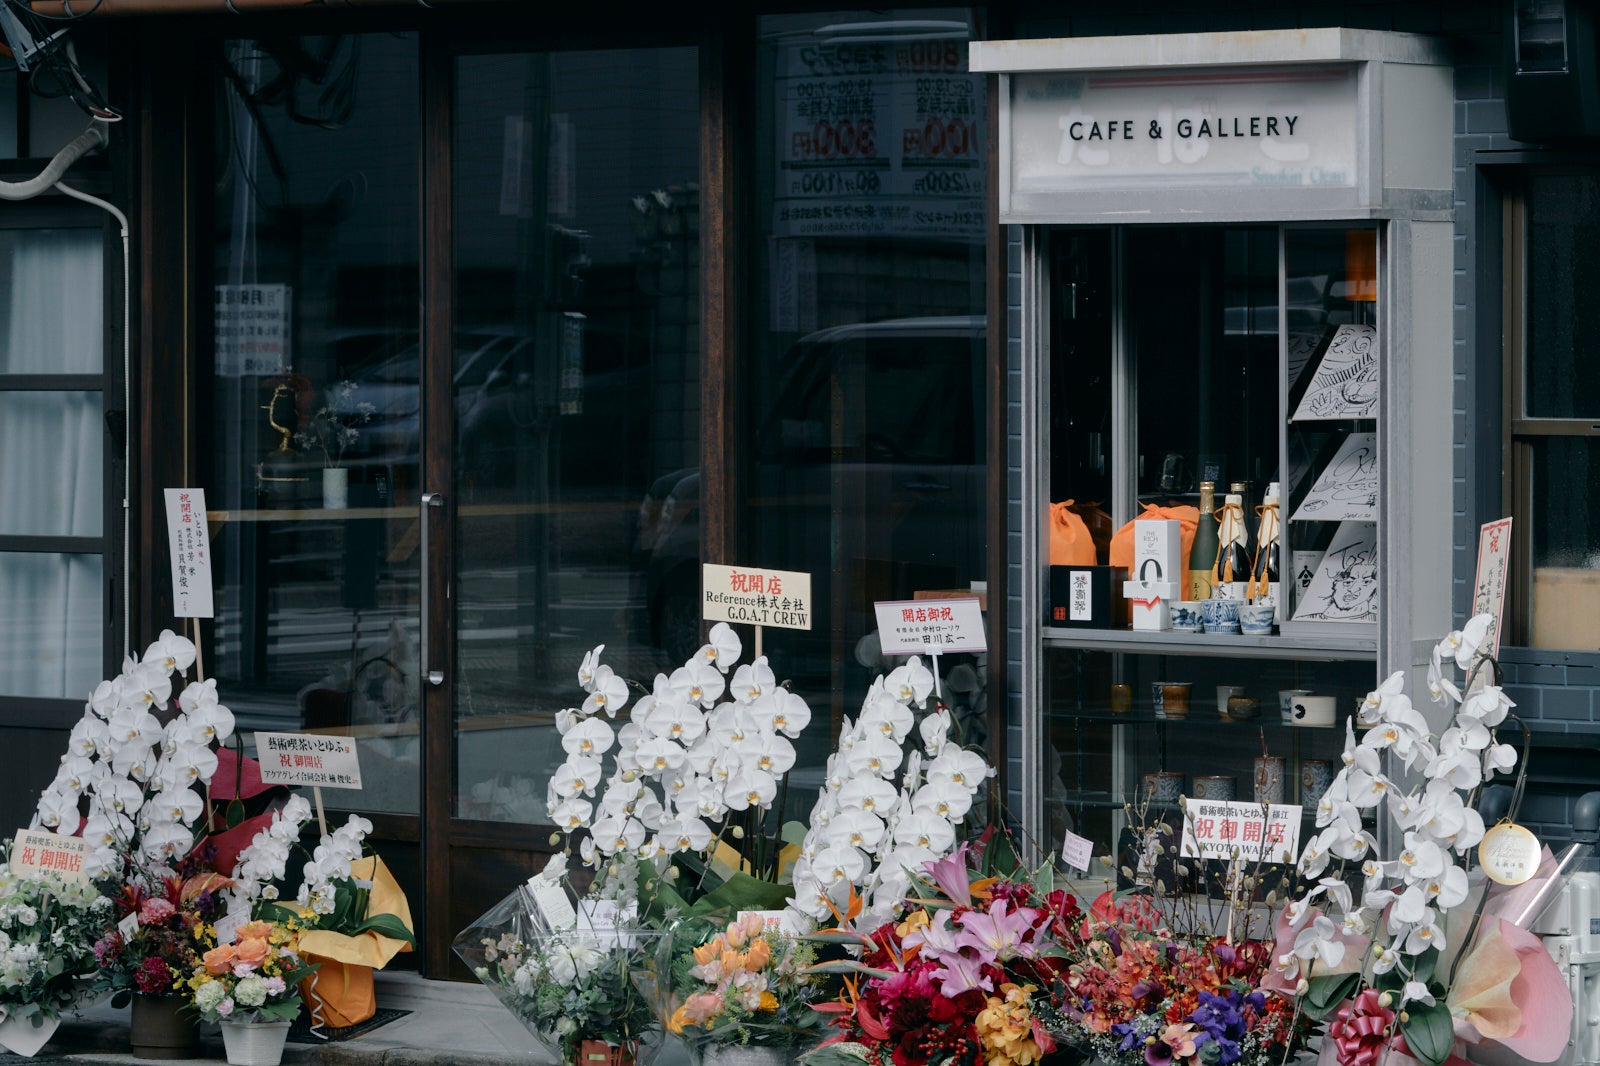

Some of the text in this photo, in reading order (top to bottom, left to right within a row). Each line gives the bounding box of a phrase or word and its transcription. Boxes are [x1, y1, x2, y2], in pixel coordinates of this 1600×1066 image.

[1068, 114, 1300, 141] CAFE & GALLERY
[179, 493, 192, 523] 祝開店
[730, 569, 783, 595] 祝開店
[728, 606, 808, 627] G.O.A.T CREW
[901, 607, 954, 623] 開店御祝
[1196, 817, 1286, 844] 祝御開店
